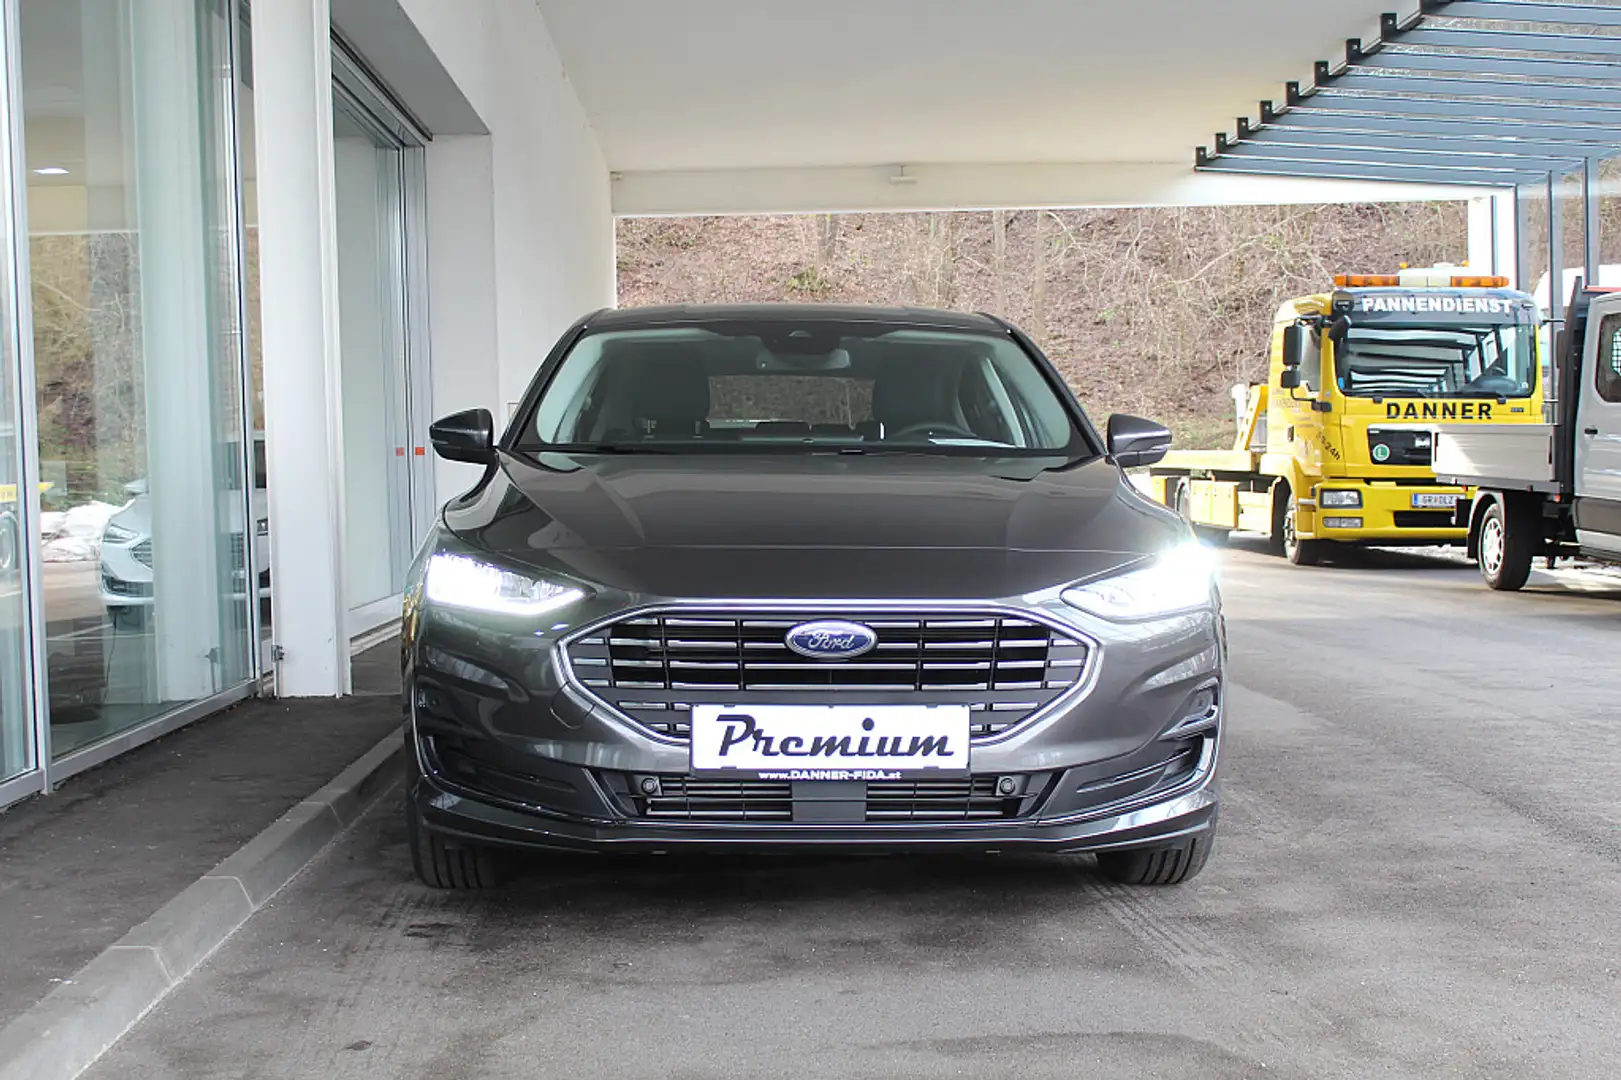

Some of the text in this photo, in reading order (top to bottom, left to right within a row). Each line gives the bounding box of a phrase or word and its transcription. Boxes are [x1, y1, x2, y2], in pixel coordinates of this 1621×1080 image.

[1362, 297, 1513, 313] PANNENDIENST
[1386, 402, 1492, 419] DANNER
[808, 633, 855, 649] Ford
[716, 714, 954, 757] Premium
[758, 769, 903, 781] www.DANNER-FIDA.at
